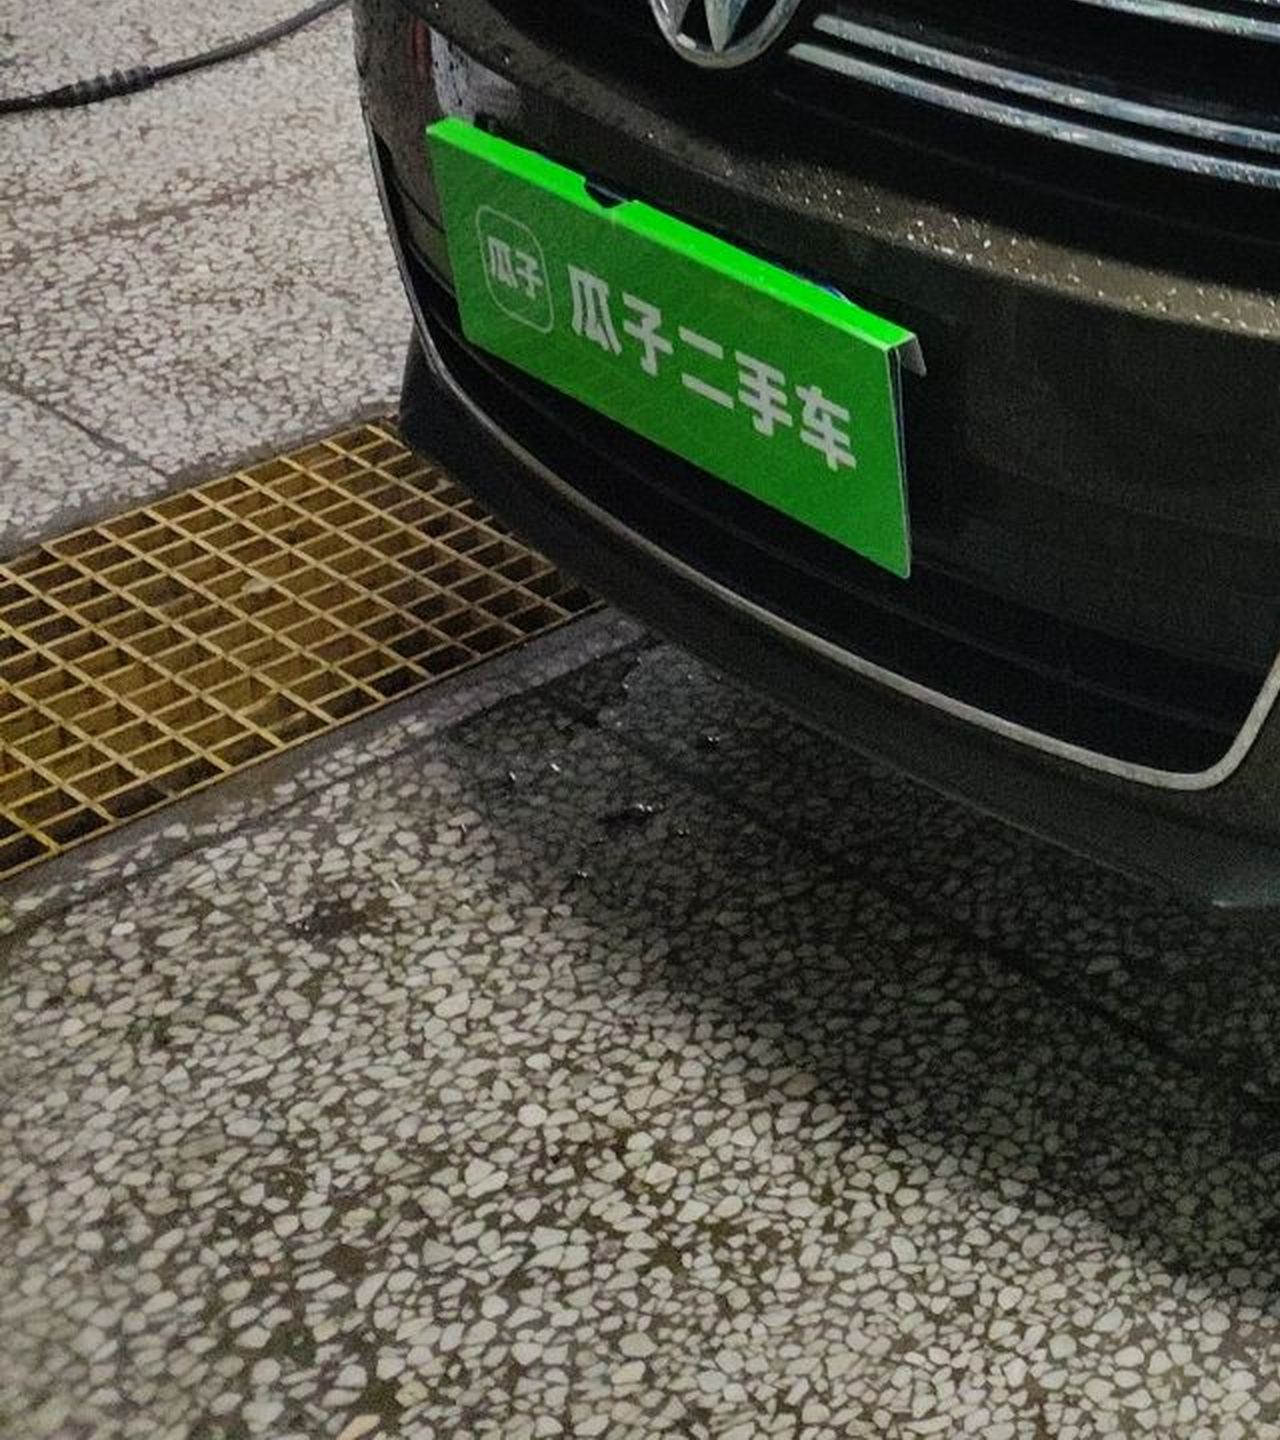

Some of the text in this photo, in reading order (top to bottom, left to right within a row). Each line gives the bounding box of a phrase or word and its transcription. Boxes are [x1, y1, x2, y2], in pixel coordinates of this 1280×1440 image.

[487, 236, 544, 299] 瓜子
[568, 265, 857, 471] 瓜子二手车
